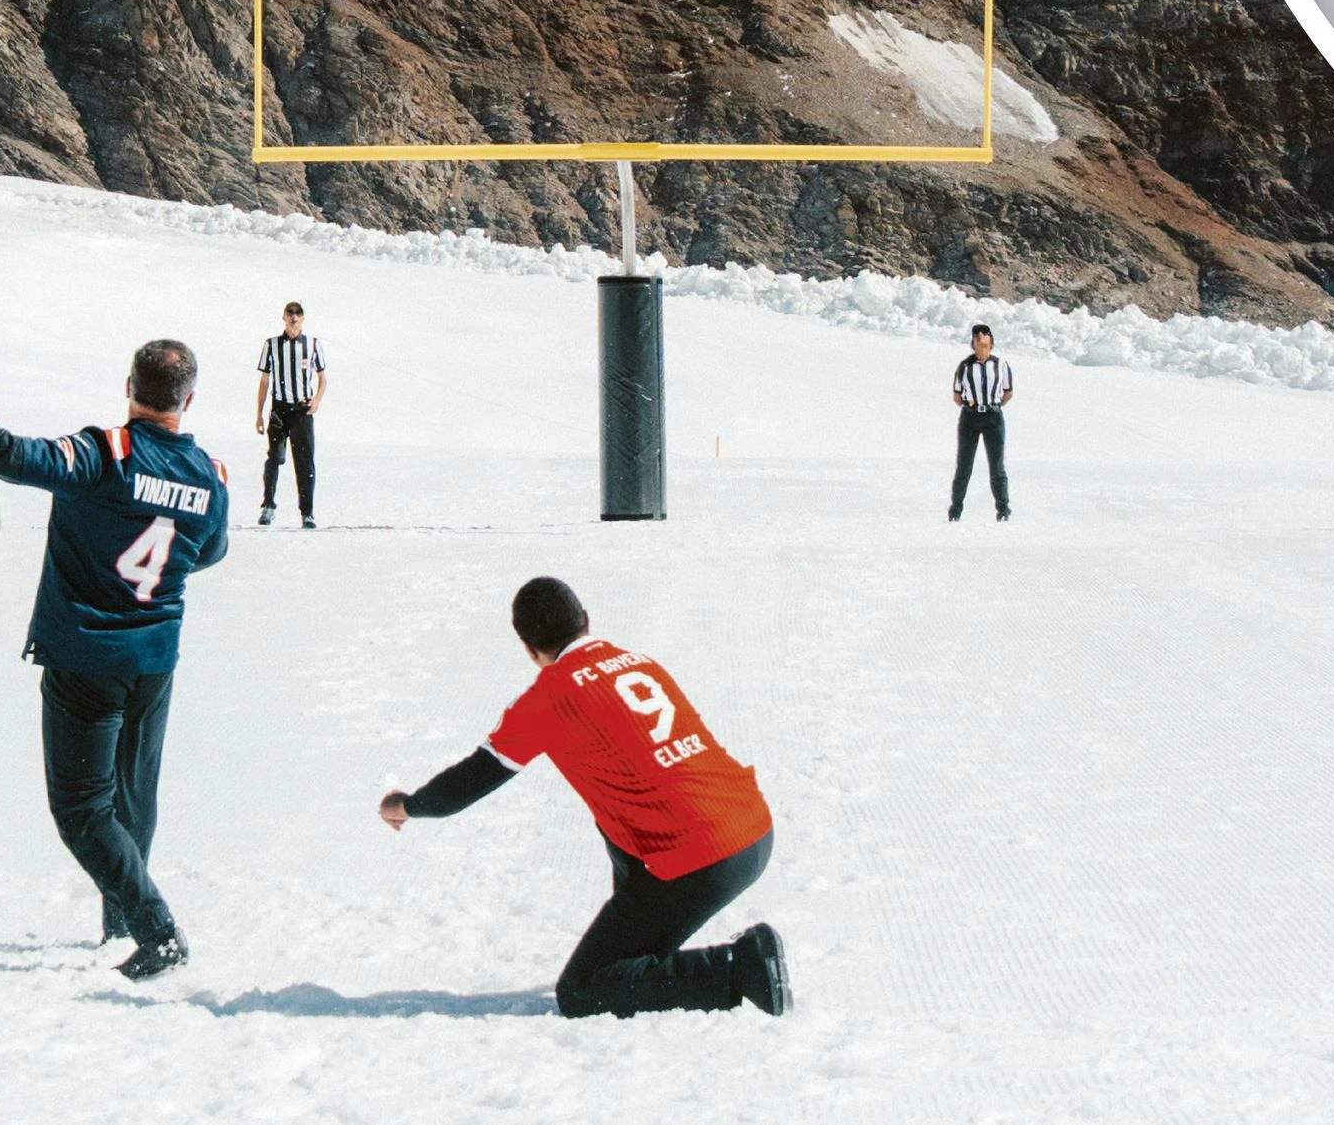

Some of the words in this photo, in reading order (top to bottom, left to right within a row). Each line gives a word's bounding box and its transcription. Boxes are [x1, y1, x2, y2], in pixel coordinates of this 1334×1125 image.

[133, 473, 211, 515] VINATIERI
[117, 515, 176, 602] 4
[572, 667, 599, 686] FC
[614, 671, 675, 744] 9
[654, 734, 708, 768] ELBER
